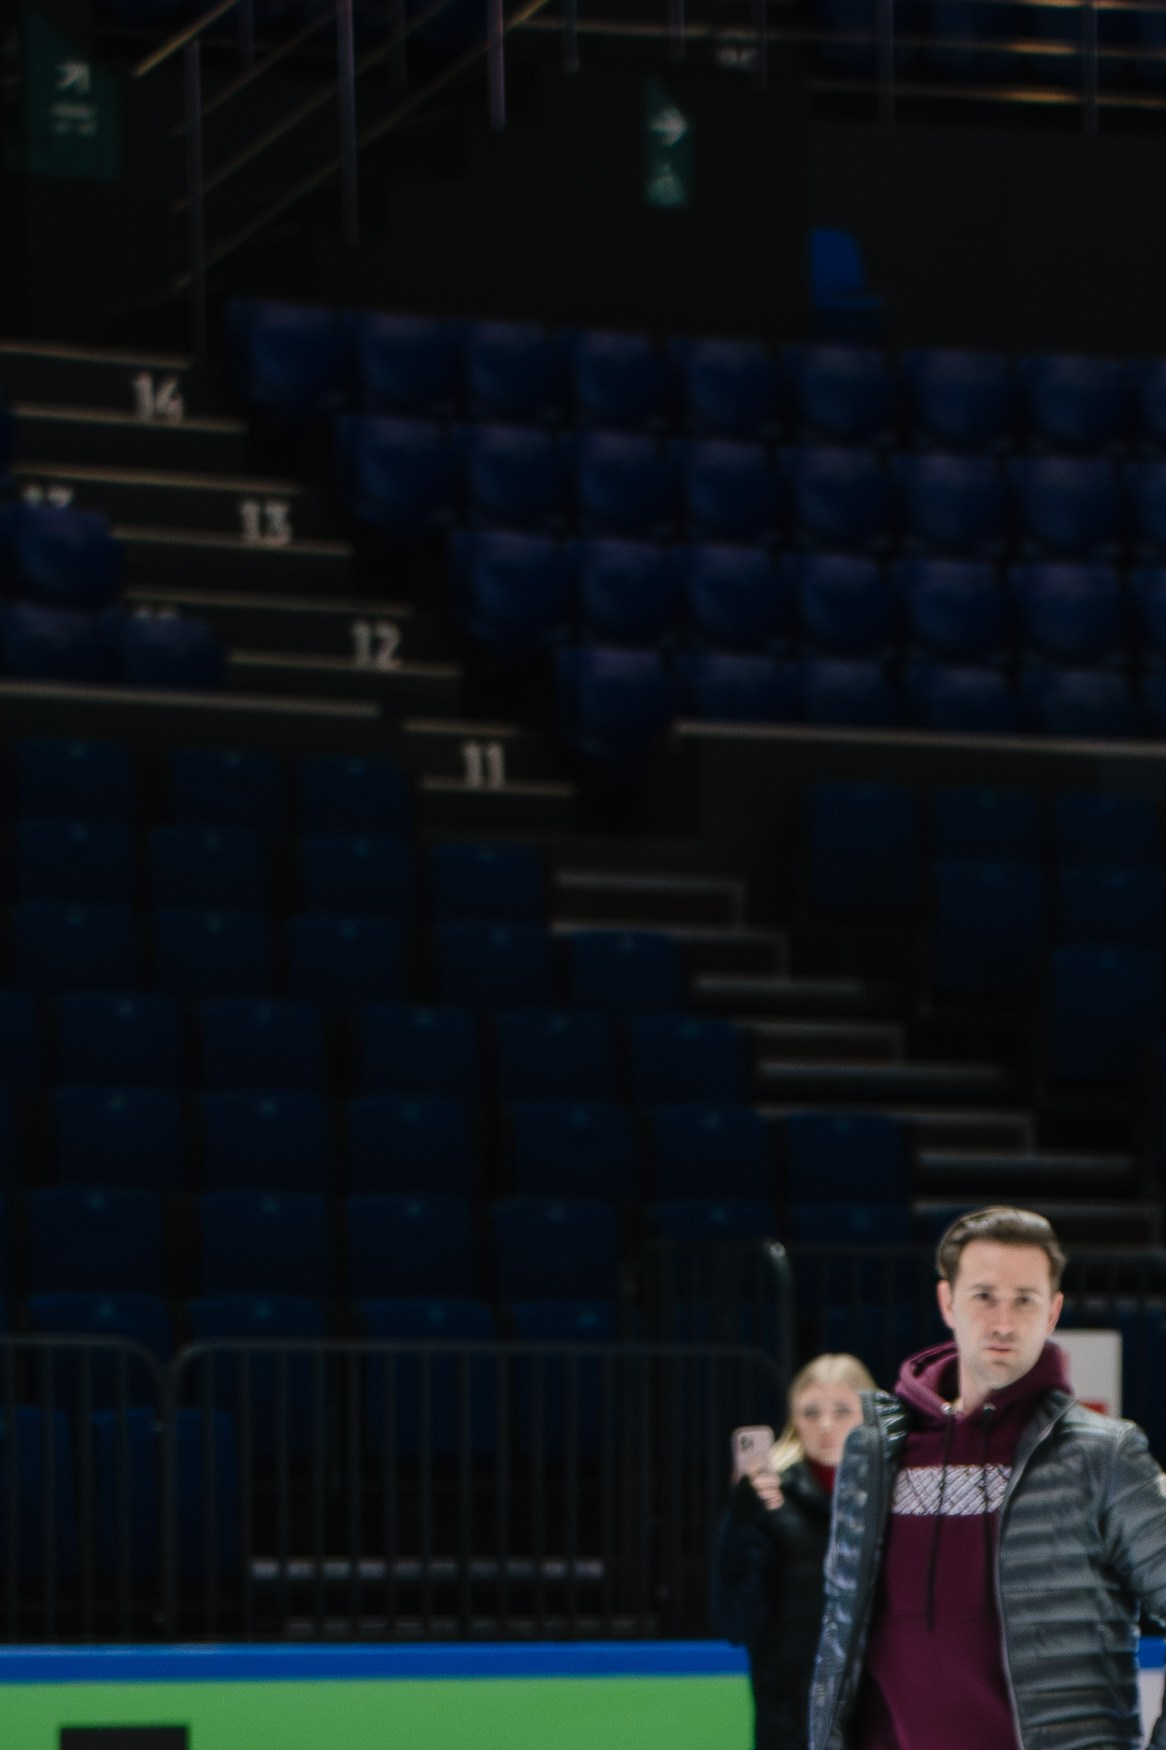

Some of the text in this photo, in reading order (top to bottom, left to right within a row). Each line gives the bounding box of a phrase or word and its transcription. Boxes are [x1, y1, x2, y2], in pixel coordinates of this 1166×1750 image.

[132, 372, 185, 424] 14
[237, 499, 293, 547] 13
[352, 619, 403, 672] 12
[460, 740, 506, 790] 11
